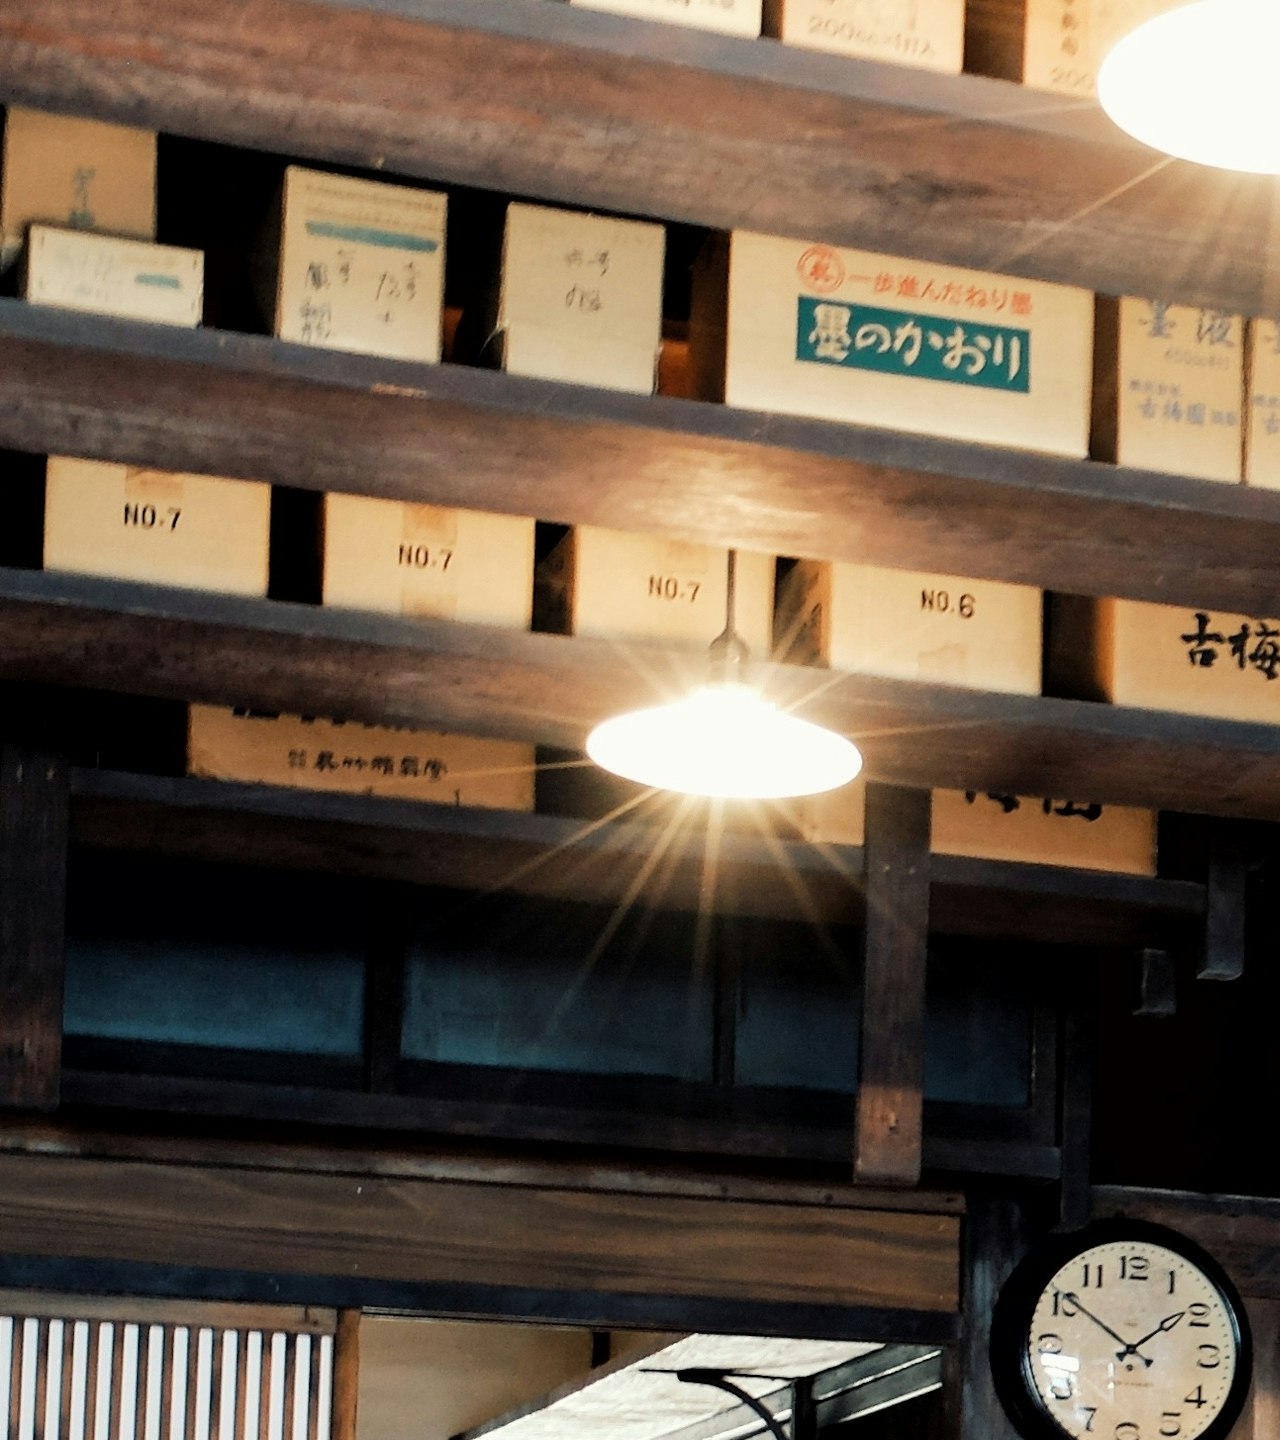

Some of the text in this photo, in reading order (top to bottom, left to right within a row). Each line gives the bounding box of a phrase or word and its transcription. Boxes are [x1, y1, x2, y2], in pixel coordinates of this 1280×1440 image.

[848, 272, 1032, 314] 一歩進んだねり墨
[808, 303, 1021, 382] 墨のかおり
[123, 502, 183, 532] NO.7
[398, 542, 454, 573] NO.7
[648, 574, 702, 604] NO.7
[921, 588, 976, 619] NO.6
[1083, 1263, 1104, 1289] 11
[1119, 1255, 1150, 1281] 12
[1167, 1269, 1176, 1295] 1
[1052, 1291, 1080, 1317] 10
[1188, 1302, 1210, 1328] 2
[1197, 1344, 1220, 1369] 3
[1184, 1385, 1207, 1409] 4
[1079, 1407, 1097, 1431] 7
[1159, 1412, 1181, 1437] 5
